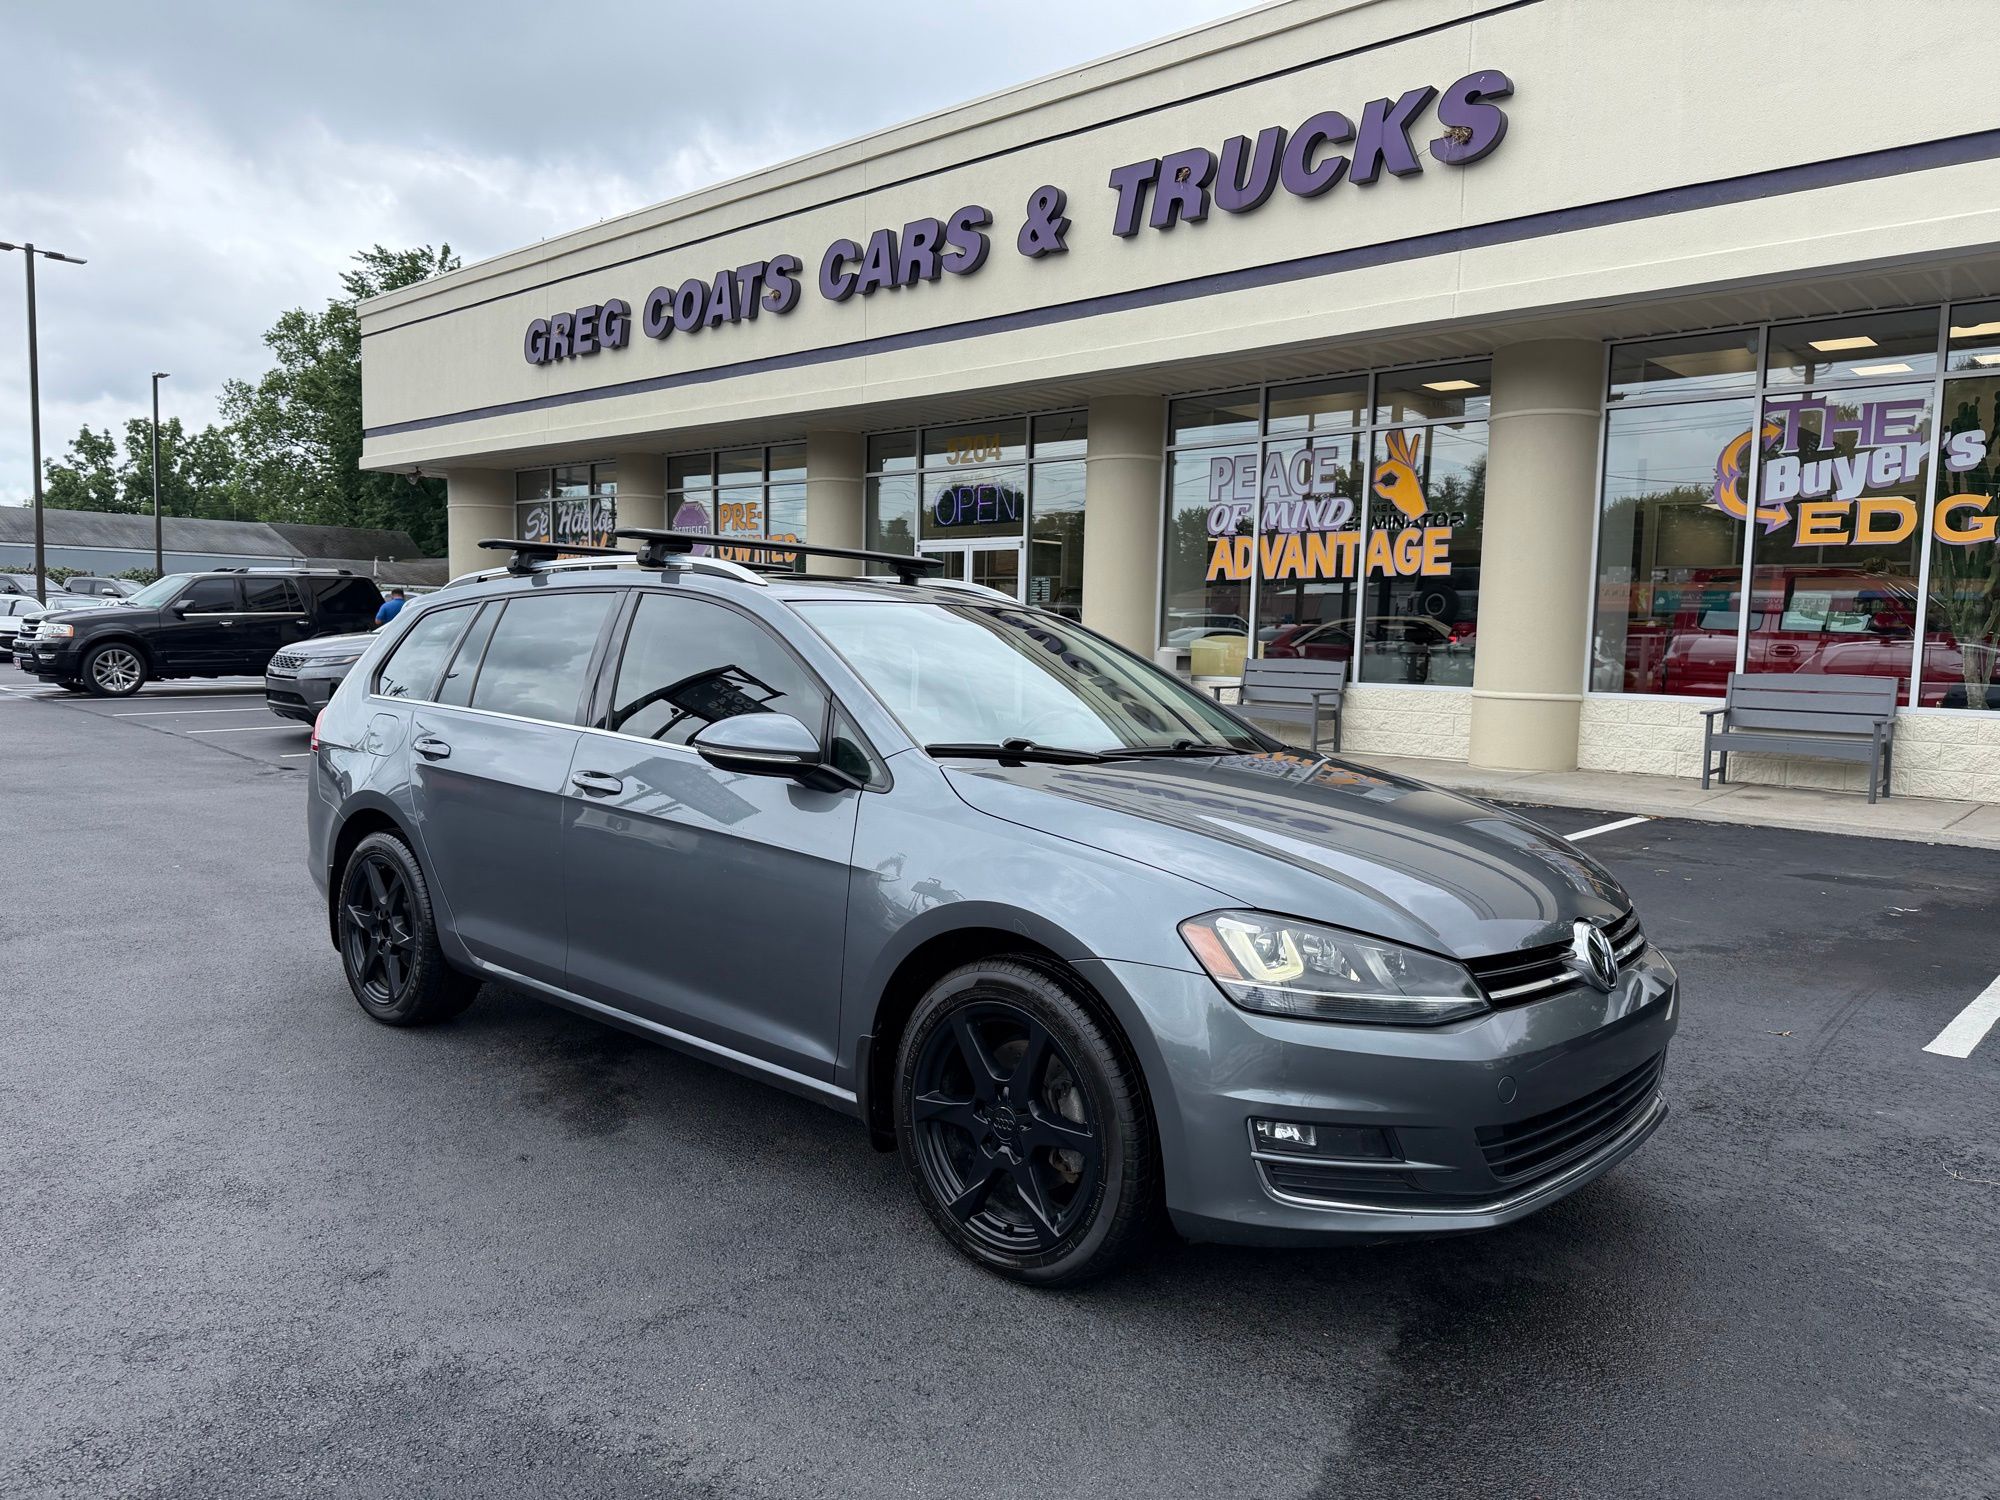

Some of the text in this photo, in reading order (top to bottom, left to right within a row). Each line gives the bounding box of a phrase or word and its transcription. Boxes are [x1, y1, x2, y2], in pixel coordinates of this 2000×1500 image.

[524, 69, 1514, 364] GREG COATS CARS & TRUCKS
[1763, 396, 1925, 453] THE
[1209, 447, 1338, 501] PEACE
[1760, 429, 1986, 504] Buyer's
[525, 501, 613, 539] Se Habla
[719, 502, 763, 531] PRE-
[934, 483, 1017, 526] OPEN
[1207, 497, 1354, 535] OF MIND
[1793, 494, 2000, 547] EDG
[1205, 526, 1453, 581] ADVANTAGE
